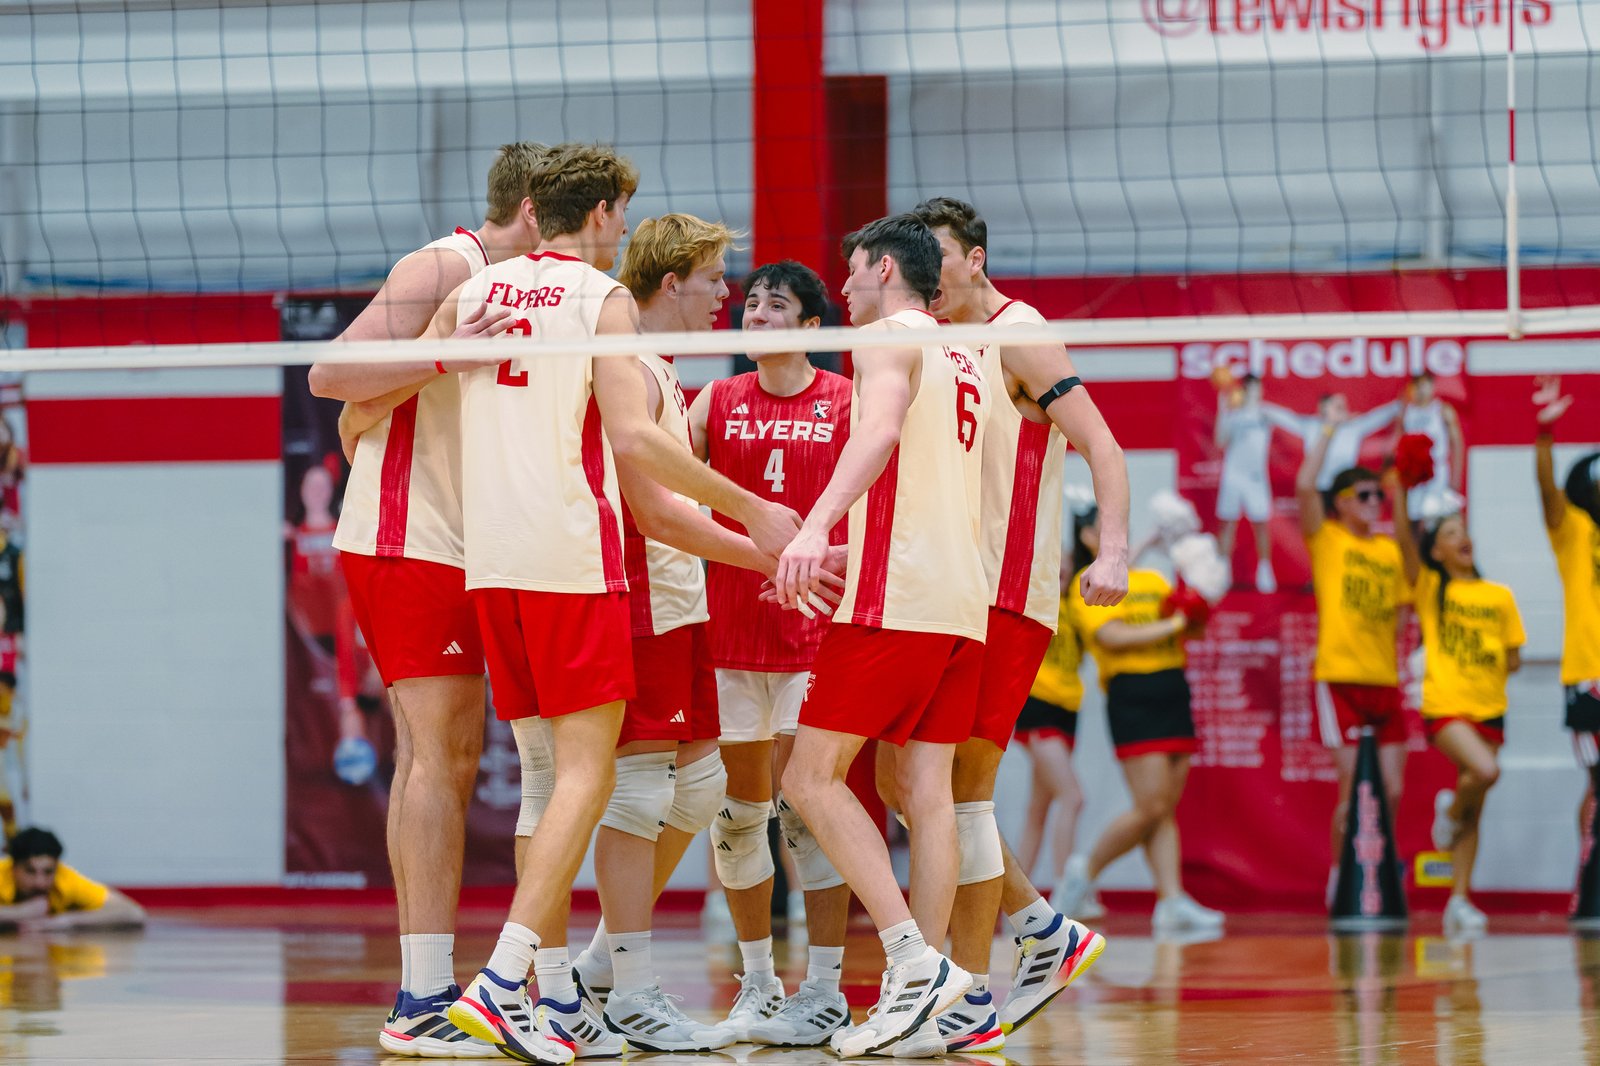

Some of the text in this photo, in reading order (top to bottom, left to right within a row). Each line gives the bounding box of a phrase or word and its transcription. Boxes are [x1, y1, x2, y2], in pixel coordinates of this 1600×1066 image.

[486, 282, 566, 311] FLYERS
[497, 318, 533, 387] 2
[1180, 336, 1464, 379] schedule
[724, 420, 834, 443] FLYERS
[955, 375, 981, 453] 6
[763, 448, 785, 493] 4
